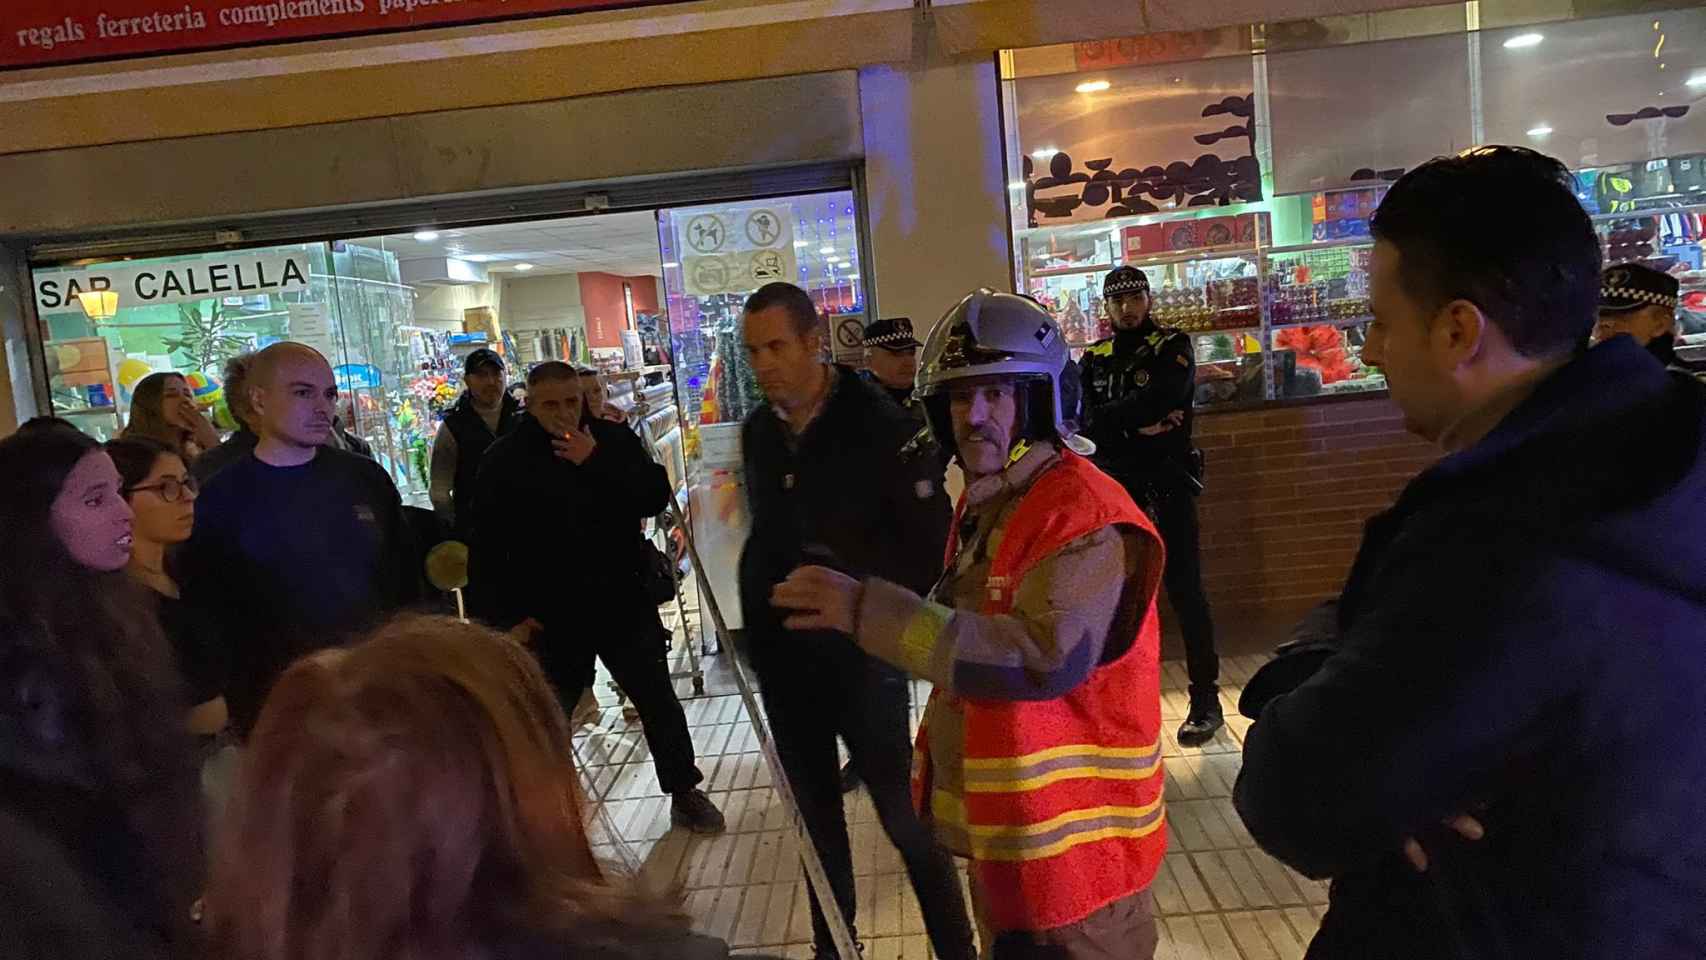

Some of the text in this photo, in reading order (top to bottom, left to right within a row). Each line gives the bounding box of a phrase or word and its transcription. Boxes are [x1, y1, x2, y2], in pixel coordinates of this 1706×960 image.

[16, 16, 85, 49] regals
[97, 4, 206, 38] ferreteria
[219, 0, 365, 27] complements
[134, 258, 307, 300] CALELLA
